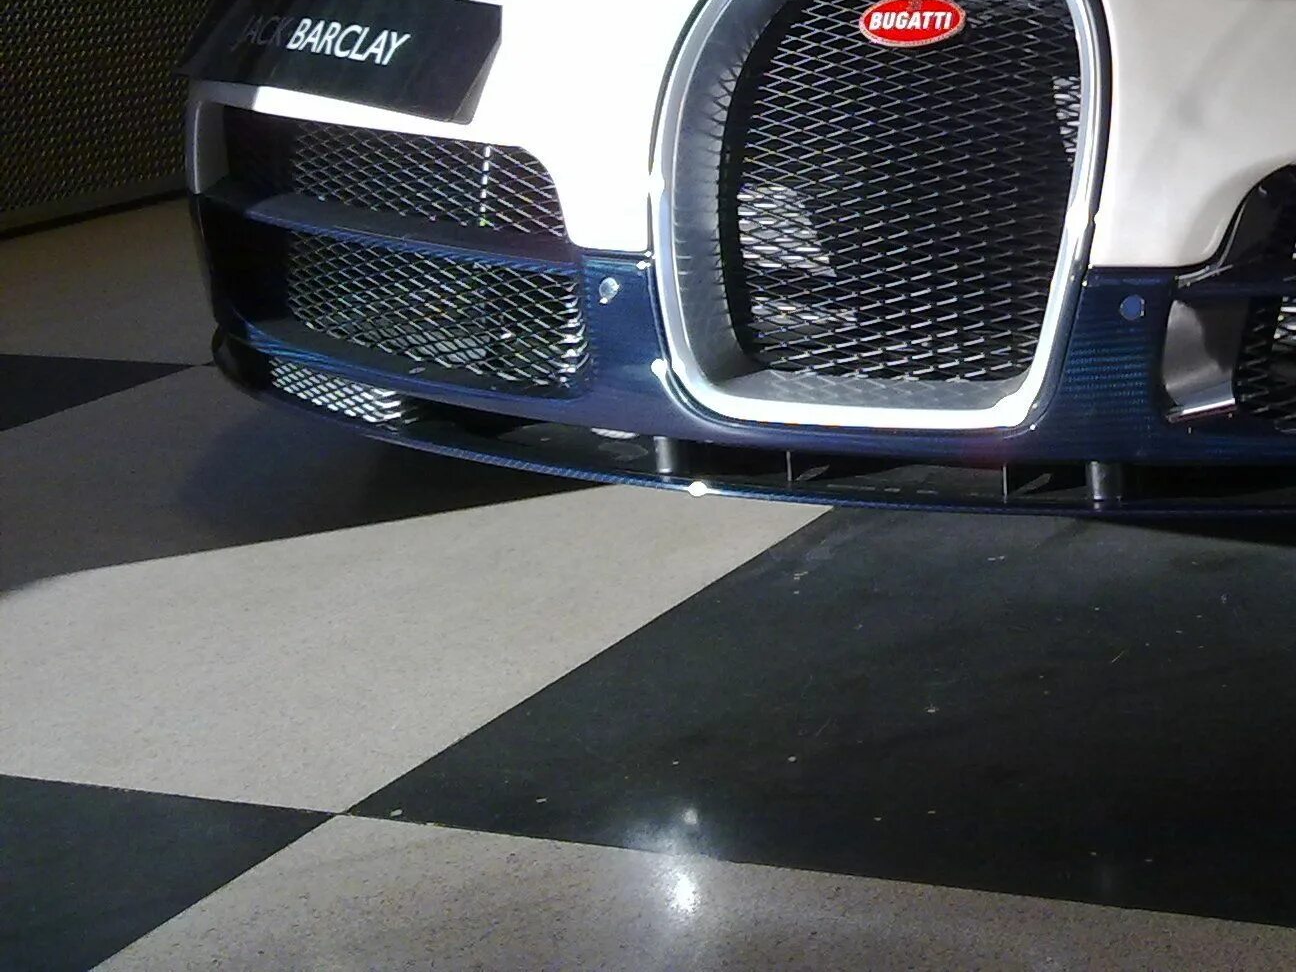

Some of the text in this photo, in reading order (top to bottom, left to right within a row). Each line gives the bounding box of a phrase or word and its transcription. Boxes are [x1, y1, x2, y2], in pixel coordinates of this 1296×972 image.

[868, 11, 953, 30] BUGATTI
[231, 14, 411, 65] JACK BARCLAY
